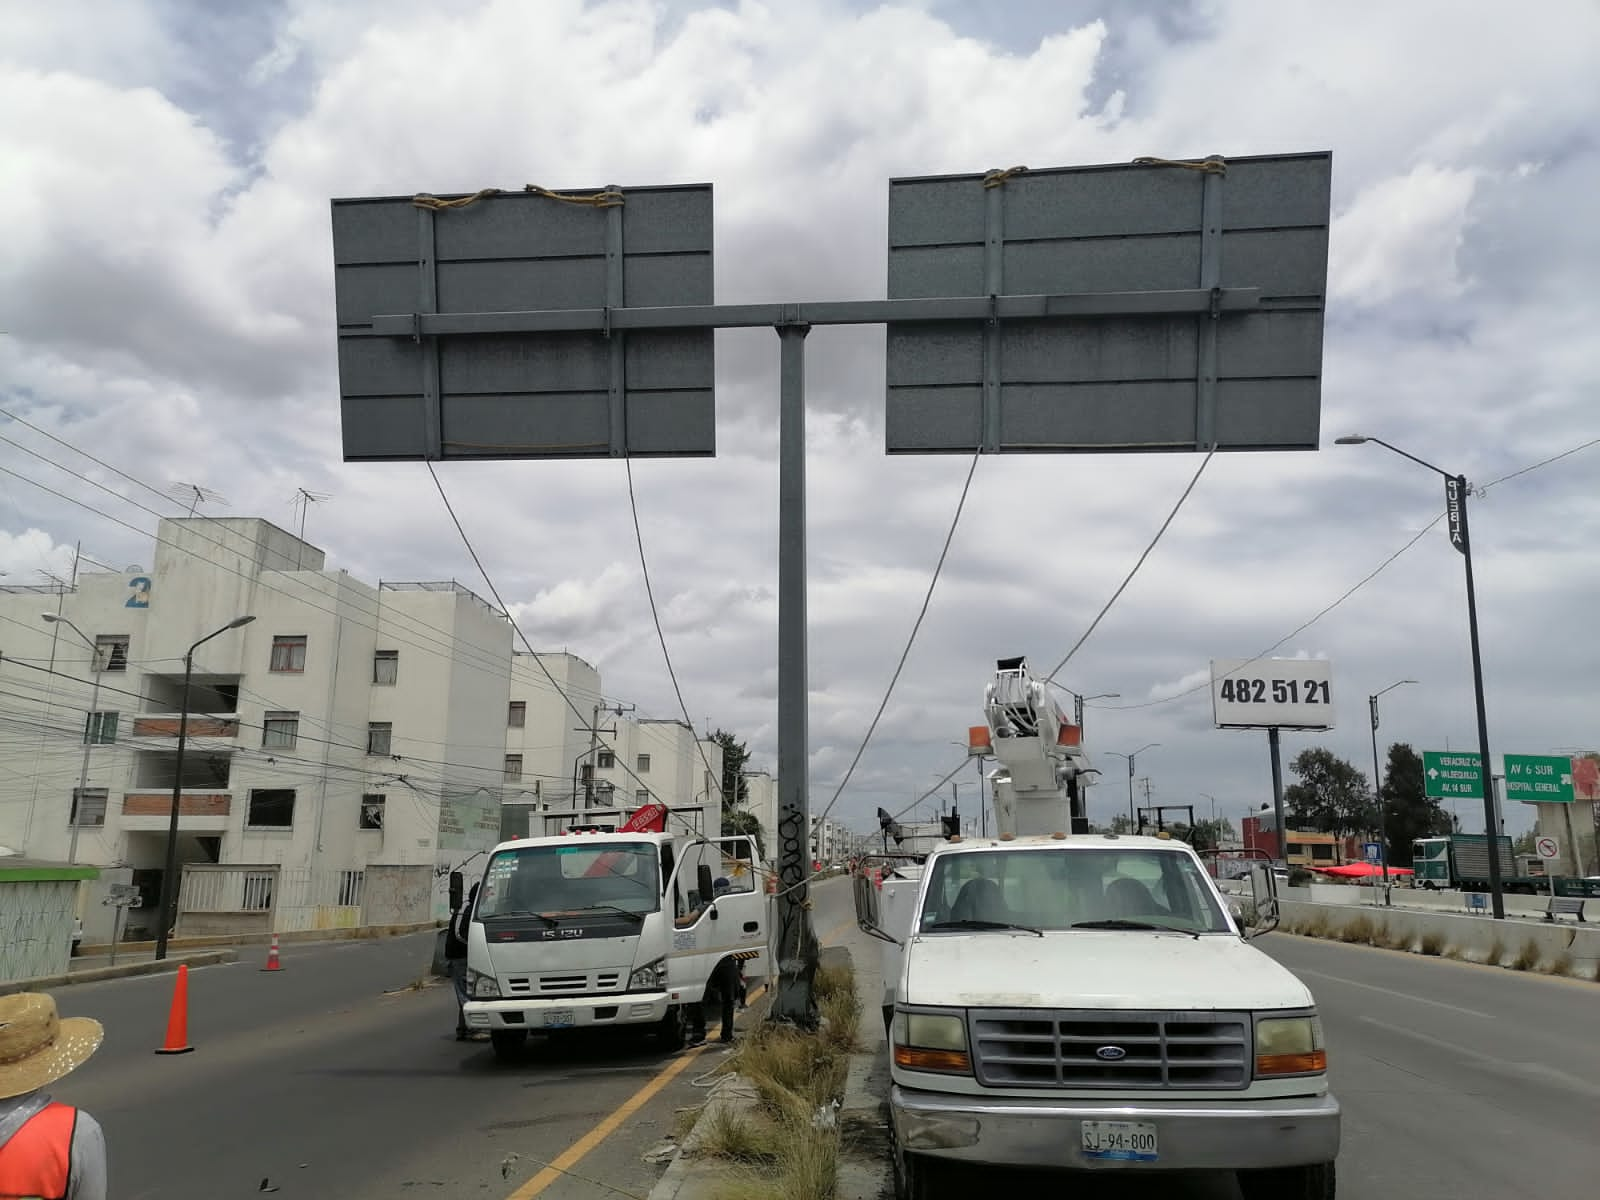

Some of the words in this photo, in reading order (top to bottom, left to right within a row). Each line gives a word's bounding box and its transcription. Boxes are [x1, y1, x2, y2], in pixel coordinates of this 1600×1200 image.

[125, 577, 152, 608] 2
[1221, 679, 1266, 703] 482
[1272, 679, 1298, 704] 51
[1304, 680, 1330, 704] 21
[1510, 764, 1521, 775] AV
[1526, 764, 1533, 775] 6
[1535, 765, 1554, 776] SUR
[1460, 784, 1473, 793] SUR
[1506, 781, 1533, 793] HOSPITAL
[1534, 783, 1560, 793] GENERAL
[1085, 1132, 1154, 1150] SJ-94-800
